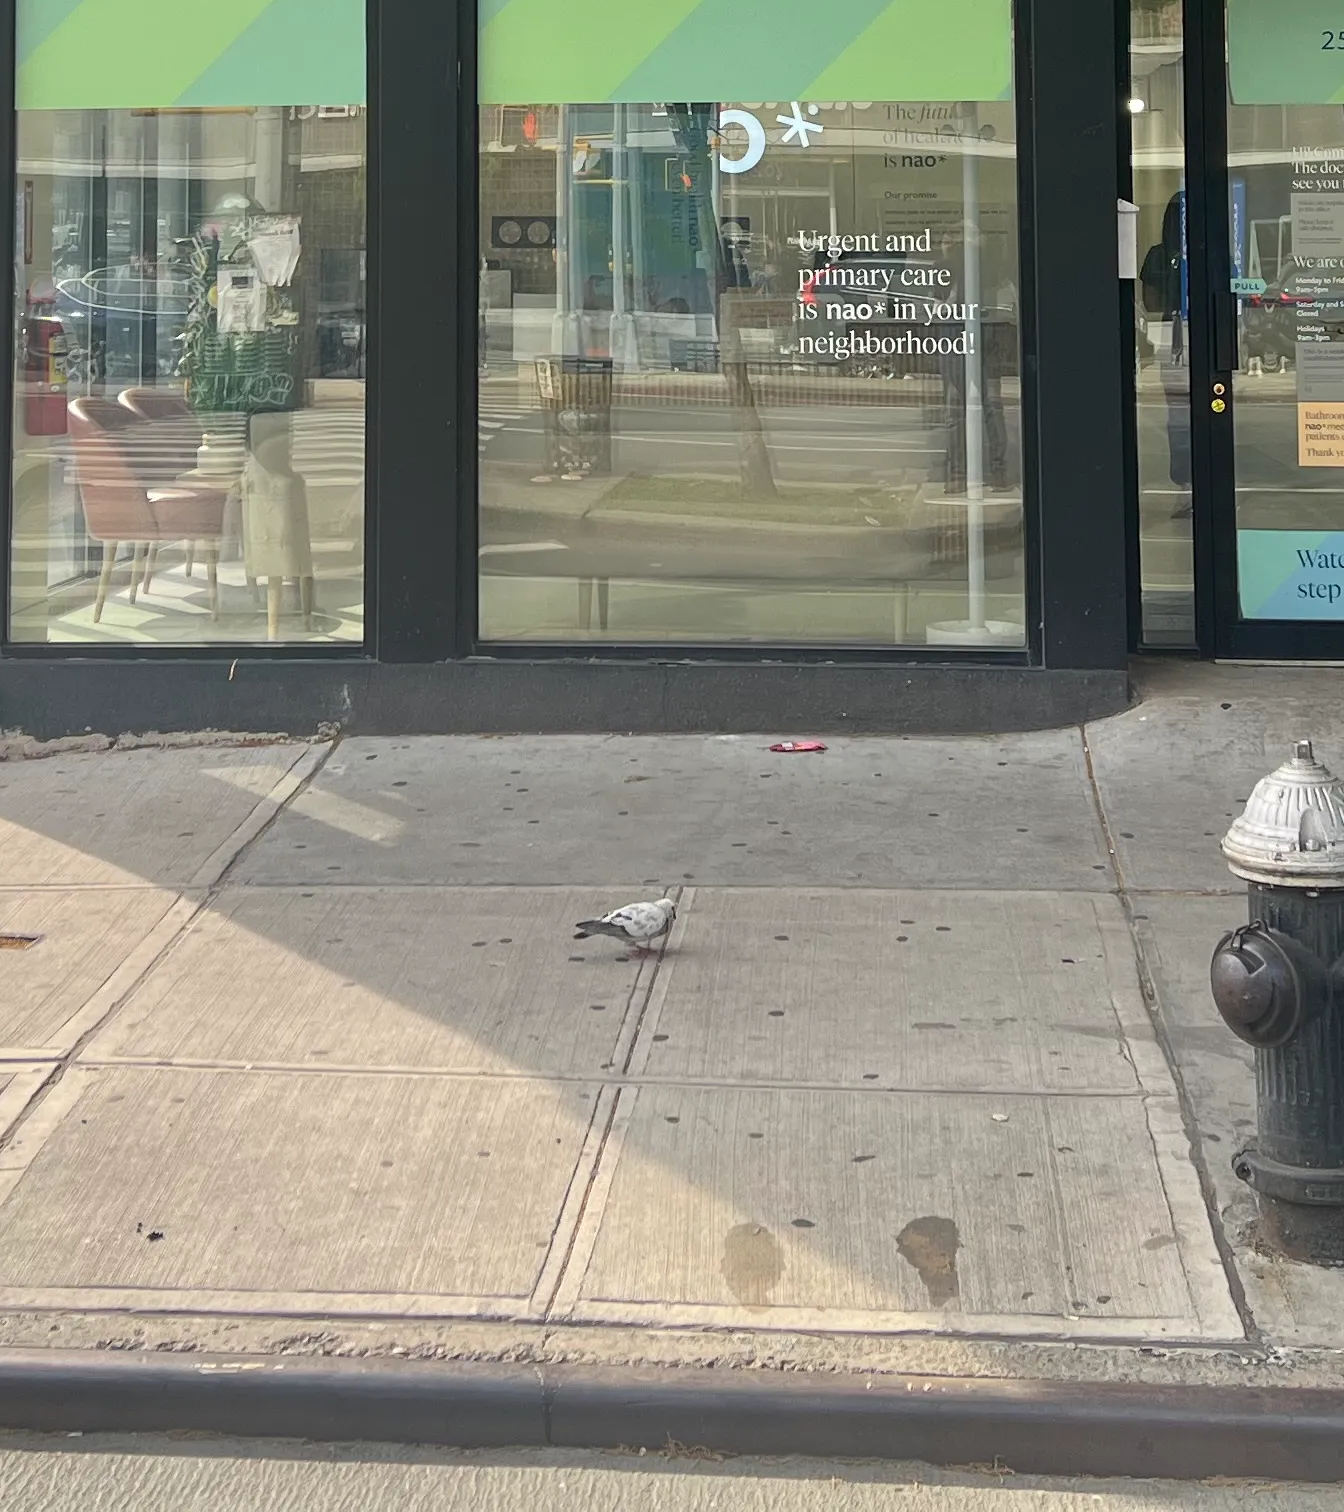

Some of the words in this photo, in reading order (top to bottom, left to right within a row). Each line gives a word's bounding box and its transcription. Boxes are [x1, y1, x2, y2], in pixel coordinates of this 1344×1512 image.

[883, 104, 916, 120] The
[884, 153, 897, 168] is
[1292, 161, 1317, 174] The
[1292, 179, 1314, 189] see
[1316, 179, 1339, 192] you
[885, 191, 901, 199] Our
[904, 191, 937, 201] promise
[798, 230, 879, 258] Urgent
[886, 229, 932, 253] and
[1294, 256, 1315, 268] We
[1317, 258, 1337, 268] are
[798, 263, 893, 294] primary
[901, 267, 951, 286] care
[1296, 277, 1322, 285] Monday
[1296, 301, 1325, 309] Saturday
[798, 299, 817, 320] is
[894, 298, 916, 320] in
[924, 302, 978, 326] your
[1297, 325, 1325, 333] Holidays
[798, 331, 976, 359] neighborhood!
[1305, 433, 1340, 442] patients
[1306, 448, 1334, 457] Thank
